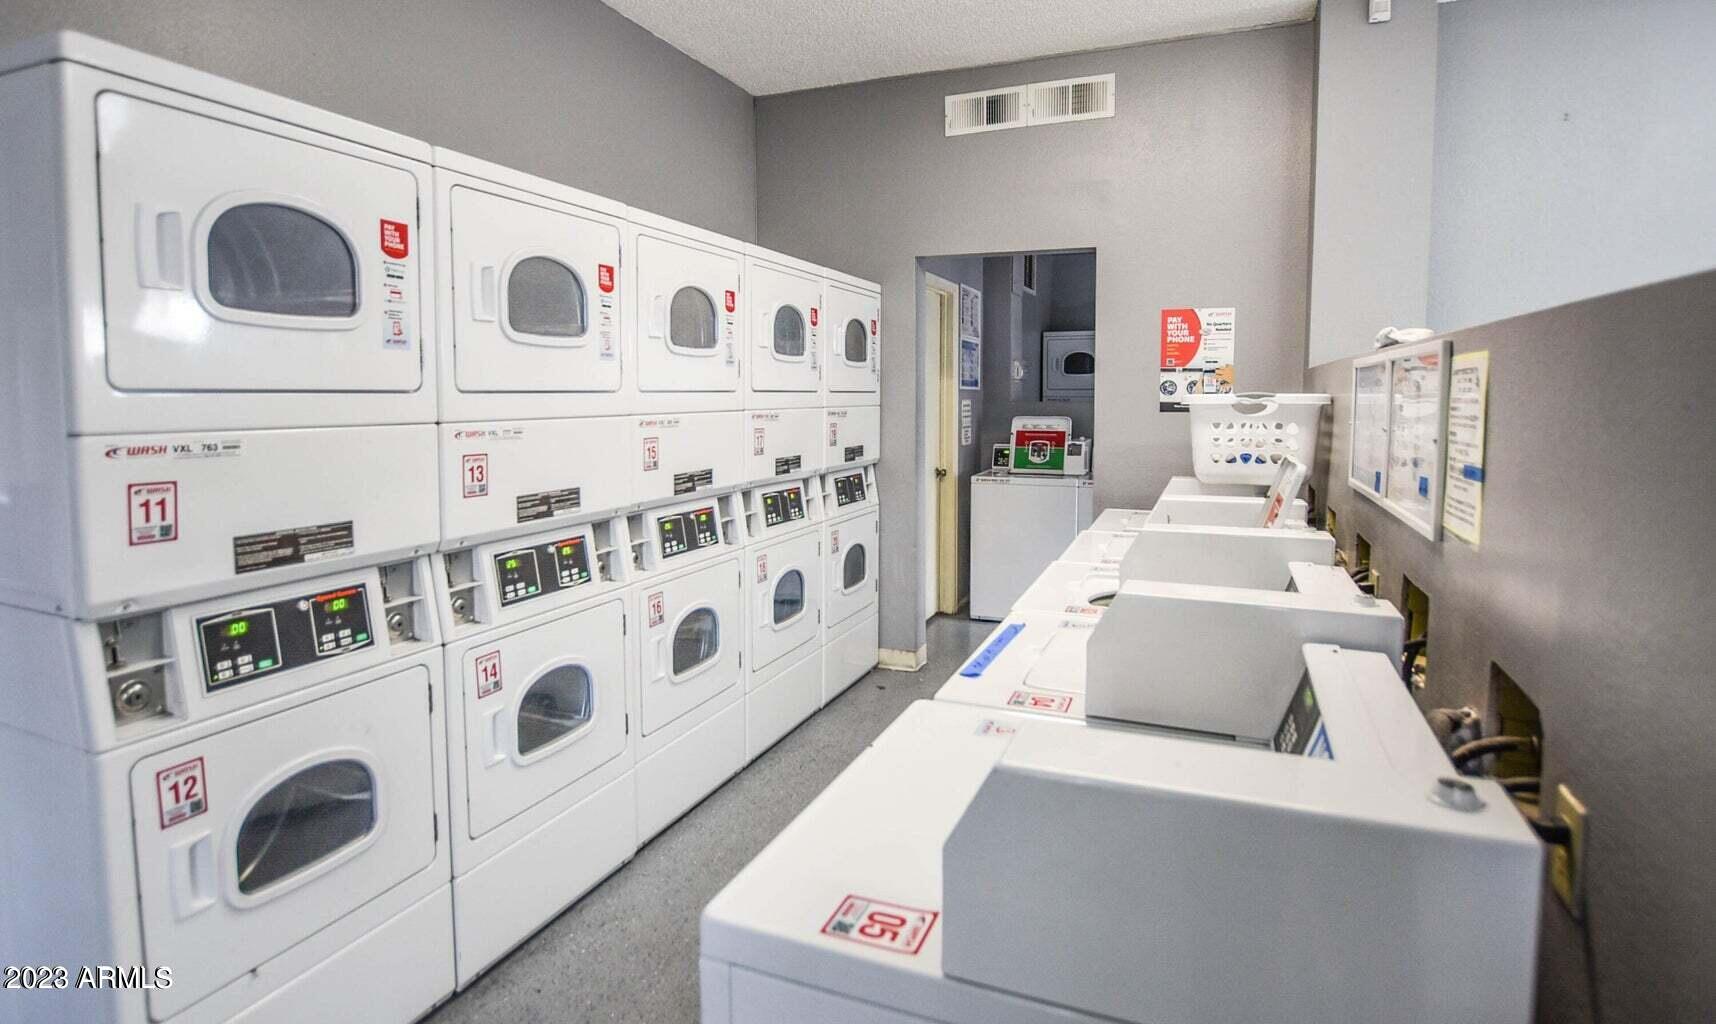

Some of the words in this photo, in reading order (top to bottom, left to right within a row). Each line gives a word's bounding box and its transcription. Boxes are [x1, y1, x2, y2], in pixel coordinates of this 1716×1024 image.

[1167, 316, 1183, 324] PAY
[1167, 329, 1189, 337] YOUR
[127, 445, 168, 456] WASH
[172, 444, 193, 453] VXL
[201, 443, 218, 452] 763
[647, 445, 656, 460] 15
[468, 464, 484, 483] 13
[139, 498, 166, 523] 11
[651, 600, 661, 616] 16
[481, 662, 498, 682] 14
[168, 775, 199, 805] 12
[858, 912, 907, 942] 05
